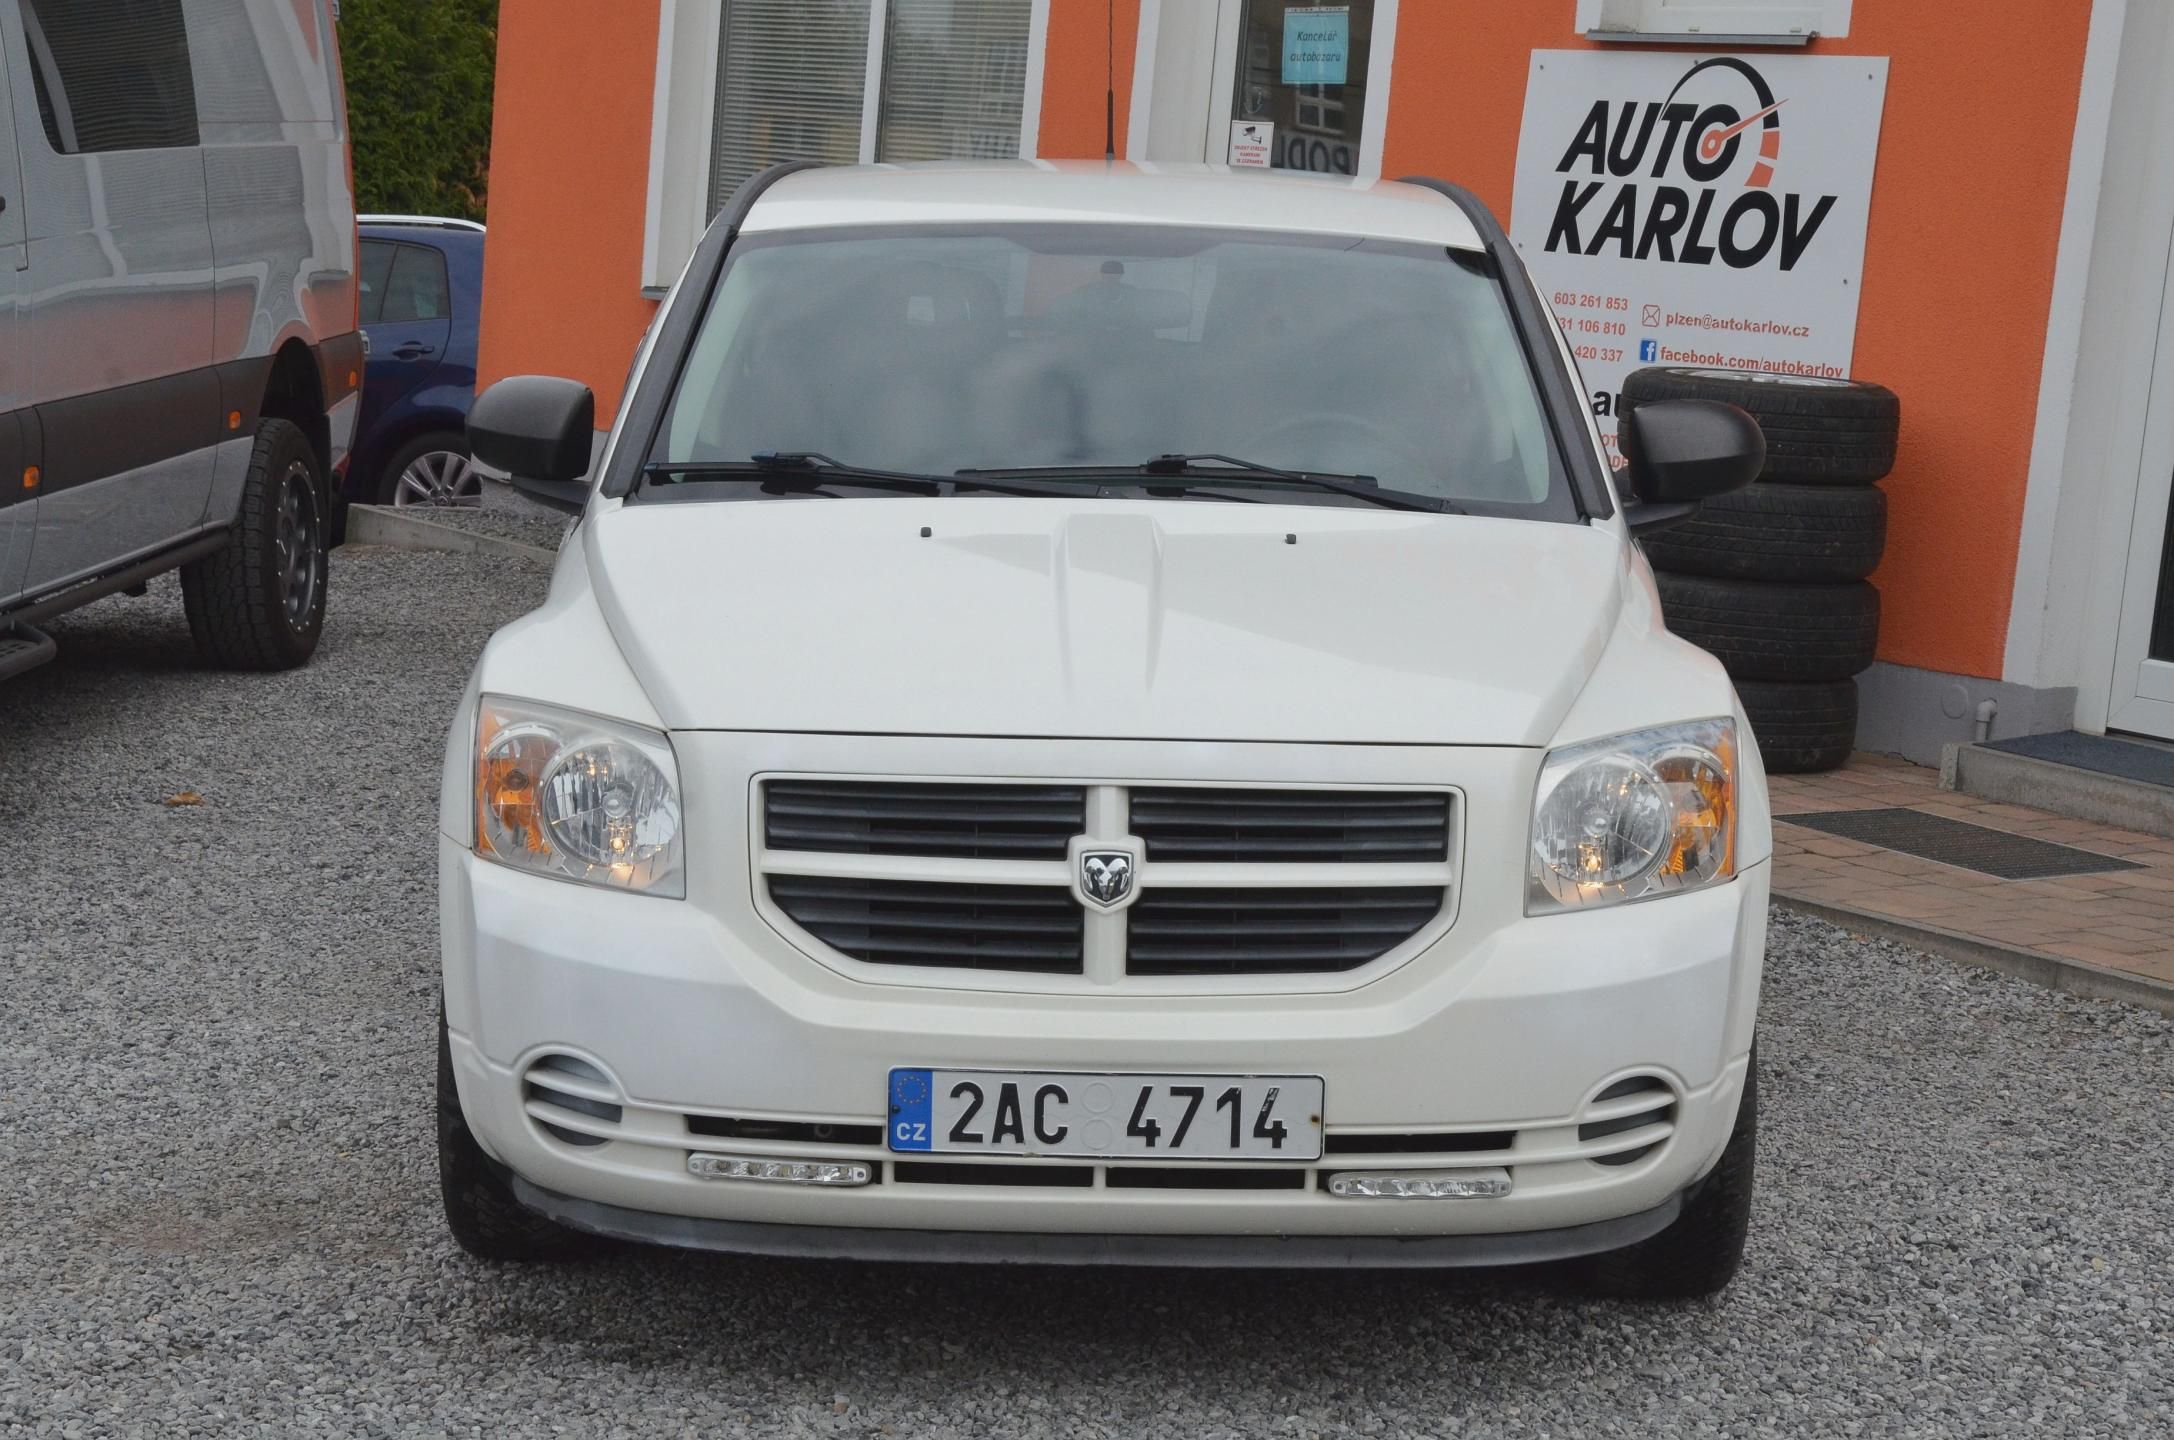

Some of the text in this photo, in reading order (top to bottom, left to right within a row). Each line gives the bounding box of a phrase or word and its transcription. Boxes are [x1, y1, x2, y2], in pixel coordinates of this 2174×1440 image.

[1290, 51, 1342, 62] autobazaru
[1555, 99, 1742, 182] AUTO
[1544, 180, 1838, 271] KARLOV
[1554, 292, 1628, 311] 603 261 853
[1557, 317, 1626, 336] 31 106 810
[1665, 311, 1810, 338] plzen@autokarlov.cz
[1574, 345, 1624, 362] 420 337
[1660, 346, 1844, 378] facebook.com/autokarlov
[896, 1081, 1289, 1149] CZ 2AC 4714
